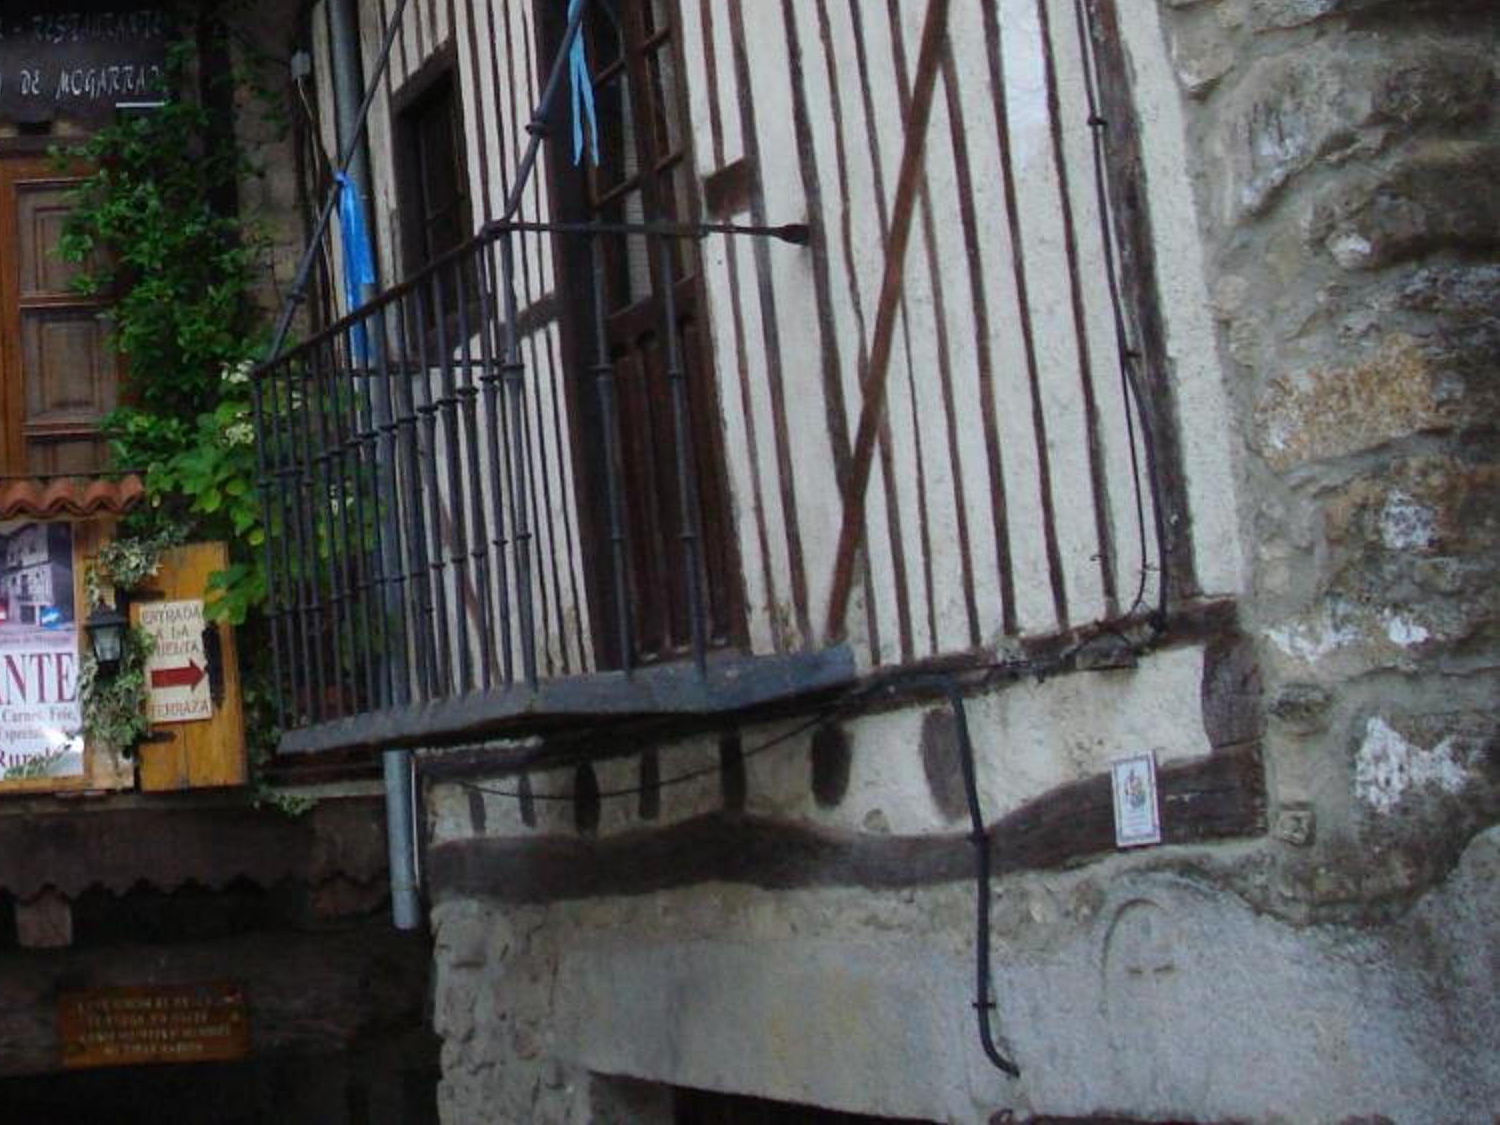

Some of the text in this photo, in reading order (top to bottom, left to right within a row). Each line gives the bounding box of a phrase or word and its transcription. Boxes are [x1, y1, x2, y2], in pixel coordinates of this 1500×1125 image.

[32, 10, 164, 44] RESTAURANTE
[19, 68, 40, 96] DE
[142, 604, 202, 625] ENTRADA
[171, 624, 189, 639] LA
[148, 700, 210, 717] TERRAZA
